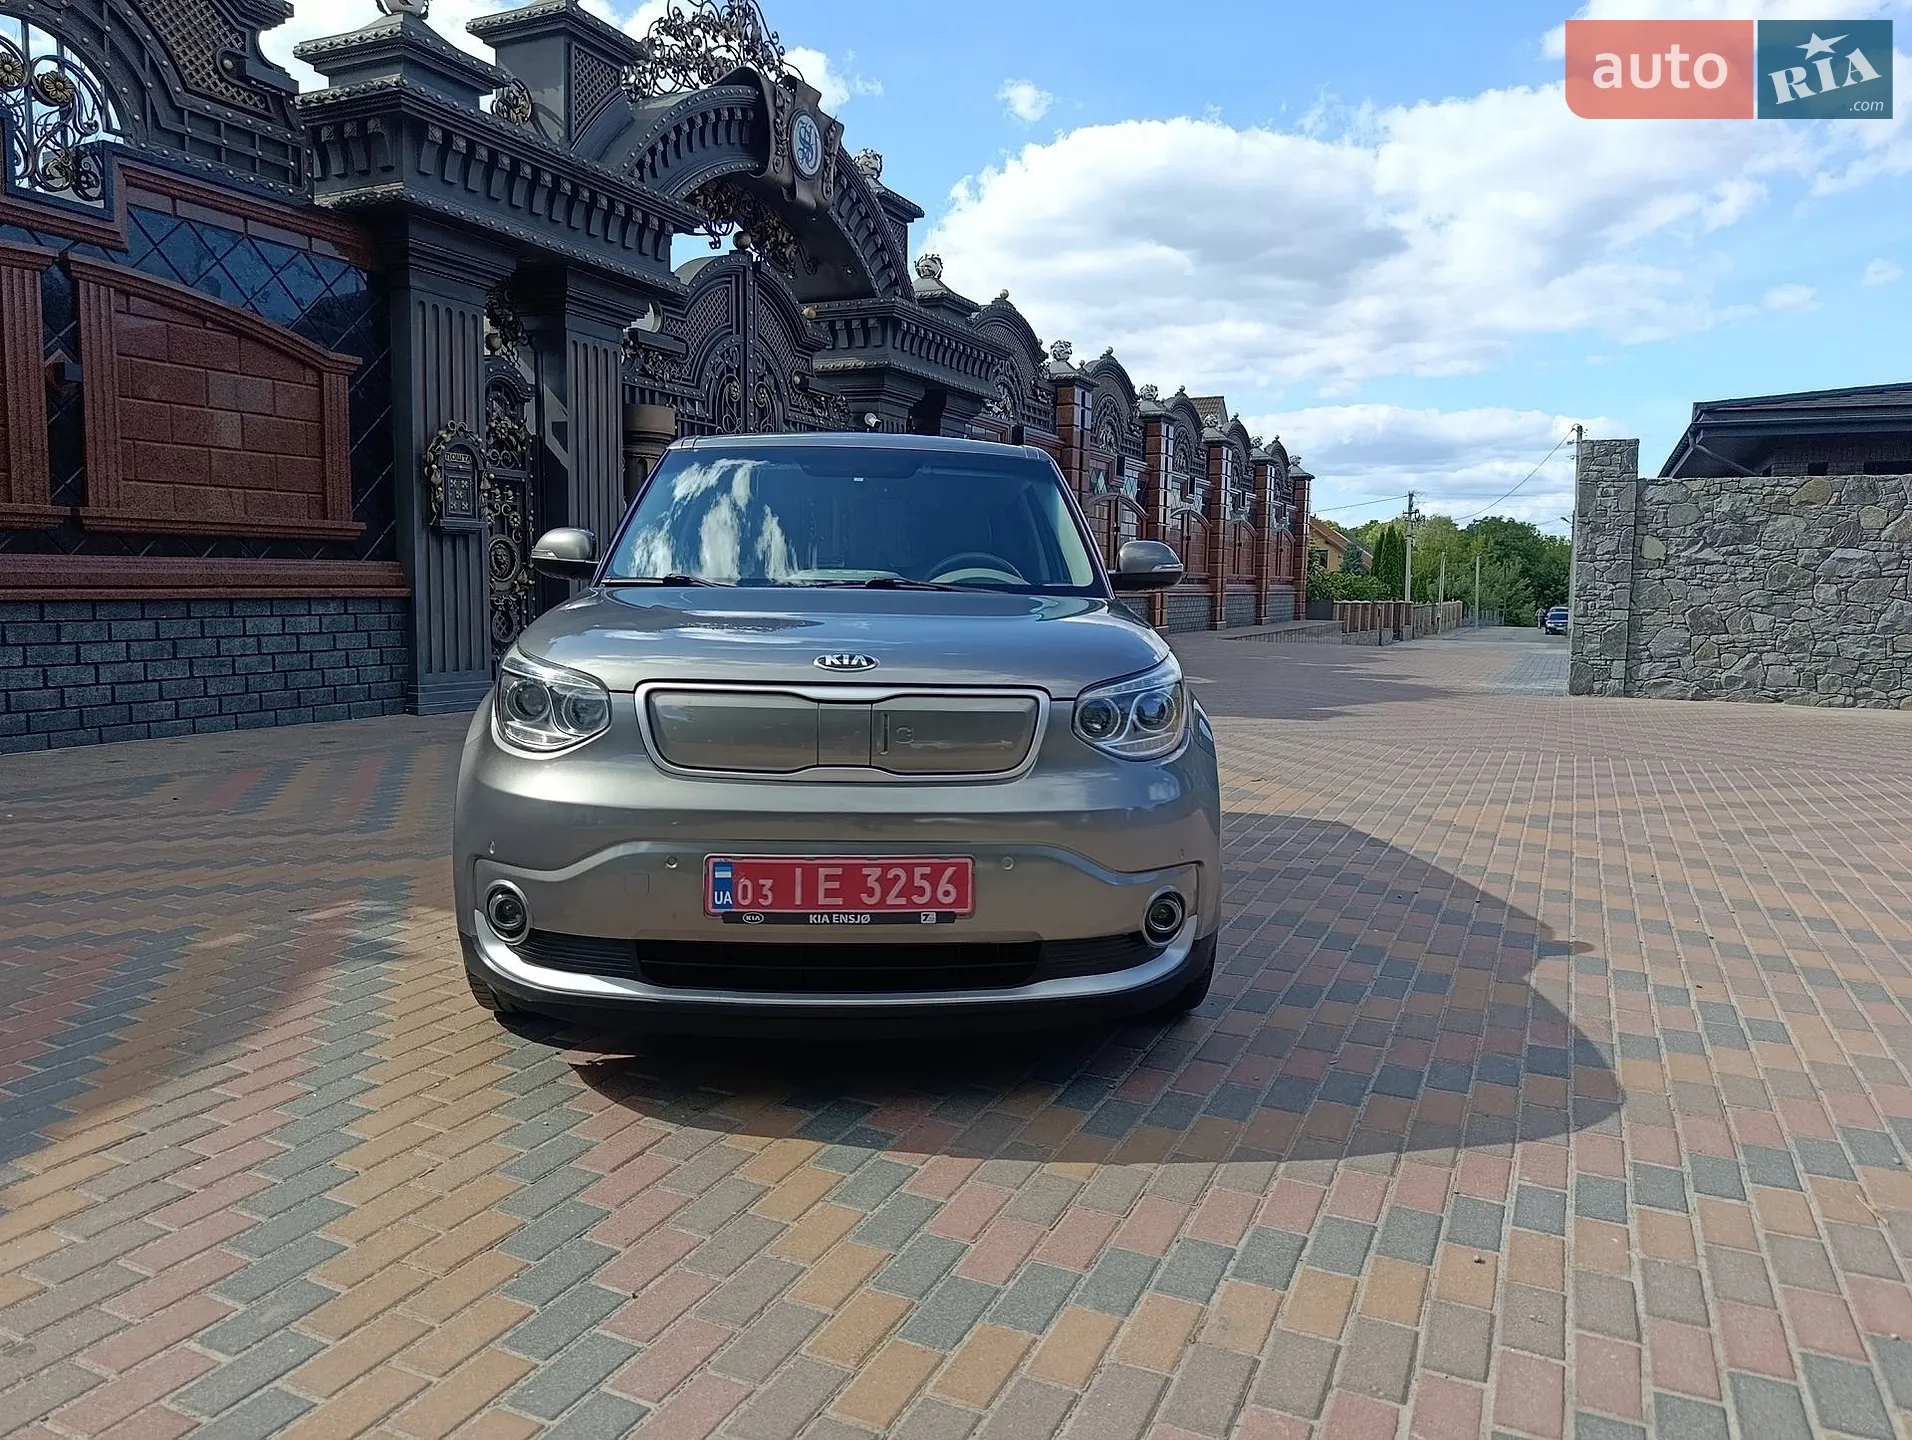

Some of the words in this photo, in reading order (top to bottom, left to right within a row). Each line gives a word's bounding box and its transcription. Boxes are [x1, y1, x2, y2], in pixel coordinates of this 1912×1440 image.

[824, 654, 868, 666] KIA
[737, 878, 774, 906] 03
[794, 867, 843, 905] IE
[860, 866, 957, 905] 3256
[714, 891, 733, 905] UA
[809, 914, 830, 924] KIA
[832, 914, 871, 925] ENSJØ
